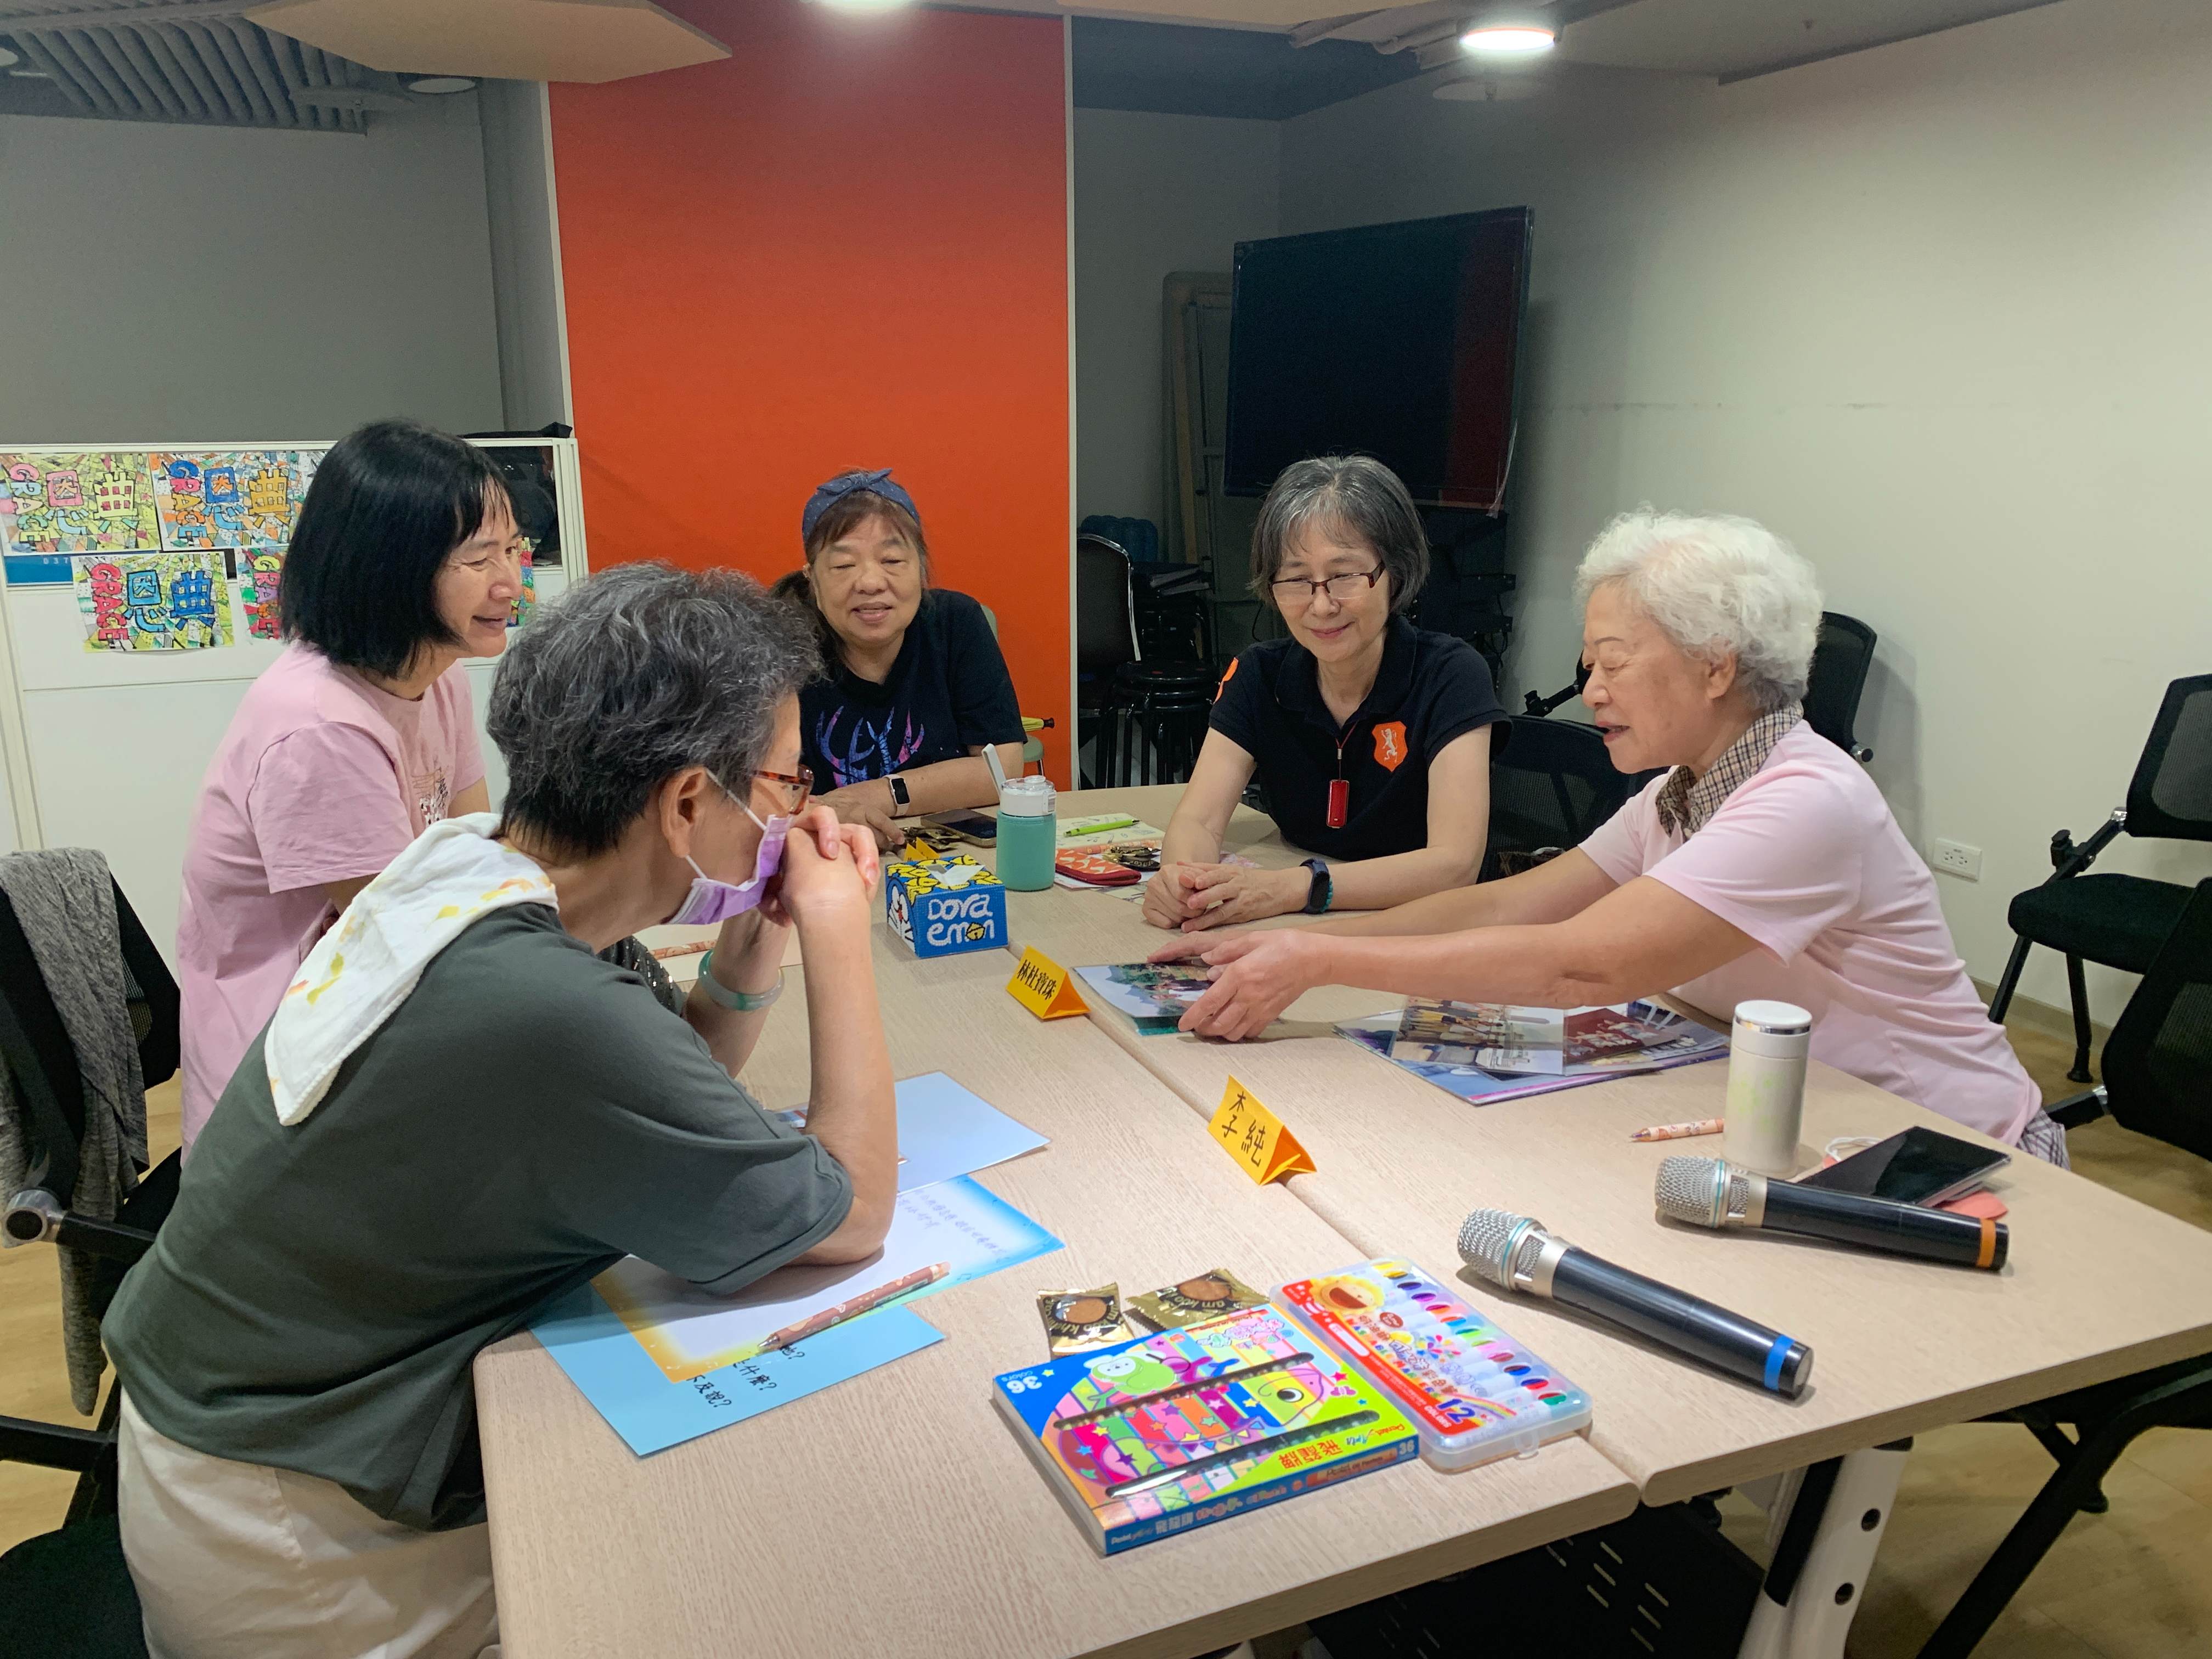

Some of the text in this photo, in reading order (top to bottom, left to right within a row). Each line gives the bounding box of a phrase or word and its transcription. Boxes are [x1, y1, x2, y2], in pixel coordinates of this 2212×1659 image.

[10, 463, 50, 543] GRACE
[44, 470, 139, 535] 恩典
[169, 461, 206, 539] GRACE
[201, 466, 291, 531] 恩典
[91, 563, 128, 640] GRACE
[123, 569, 215, 633] 恩典
[1006, 1375, 1042, 1394] 36
[1437, 1397, 1475, 1424] 12
[1375, 1423, 1405, 1436] Pentel
[1399, 1439, 1415, 1455] 36
[1424, 1406, 1453, 1429] COLORS
